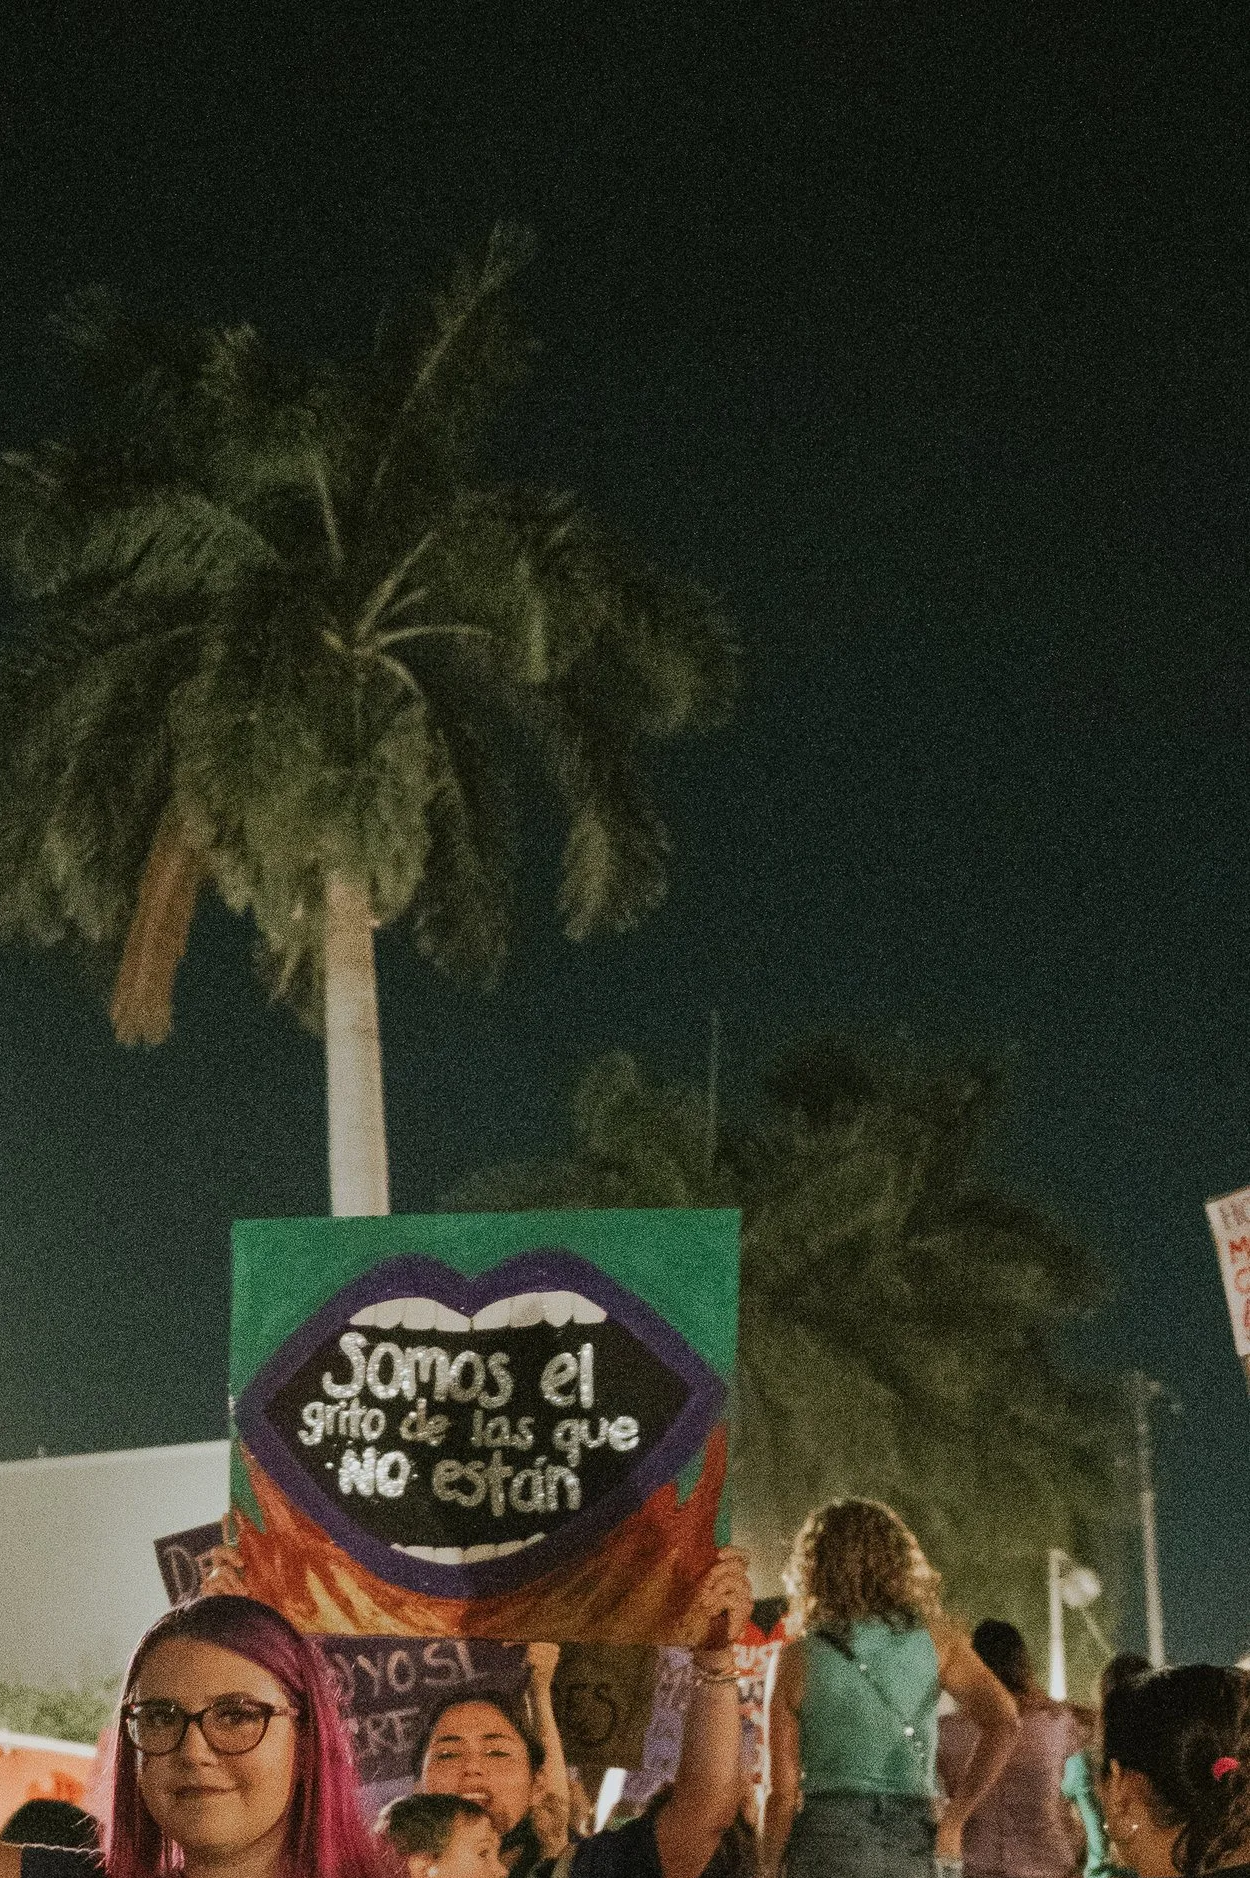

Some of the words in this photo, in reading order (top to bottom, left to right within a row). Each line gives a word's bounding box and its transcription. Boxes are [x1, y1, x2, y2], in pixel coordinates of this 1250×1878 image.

[322, 1332, 514, 1409] Somos
[541, 1343, 594, 1409] el
[298, 1400, 387, 1447] grito
[400, 1398, 449, 1447] de
[471, 1410, 534, 1451] las
[553, 1415, 640, 1467] que
[338, 1446, 412, 1498] NO
[432, 1451, 581, 1517] están
